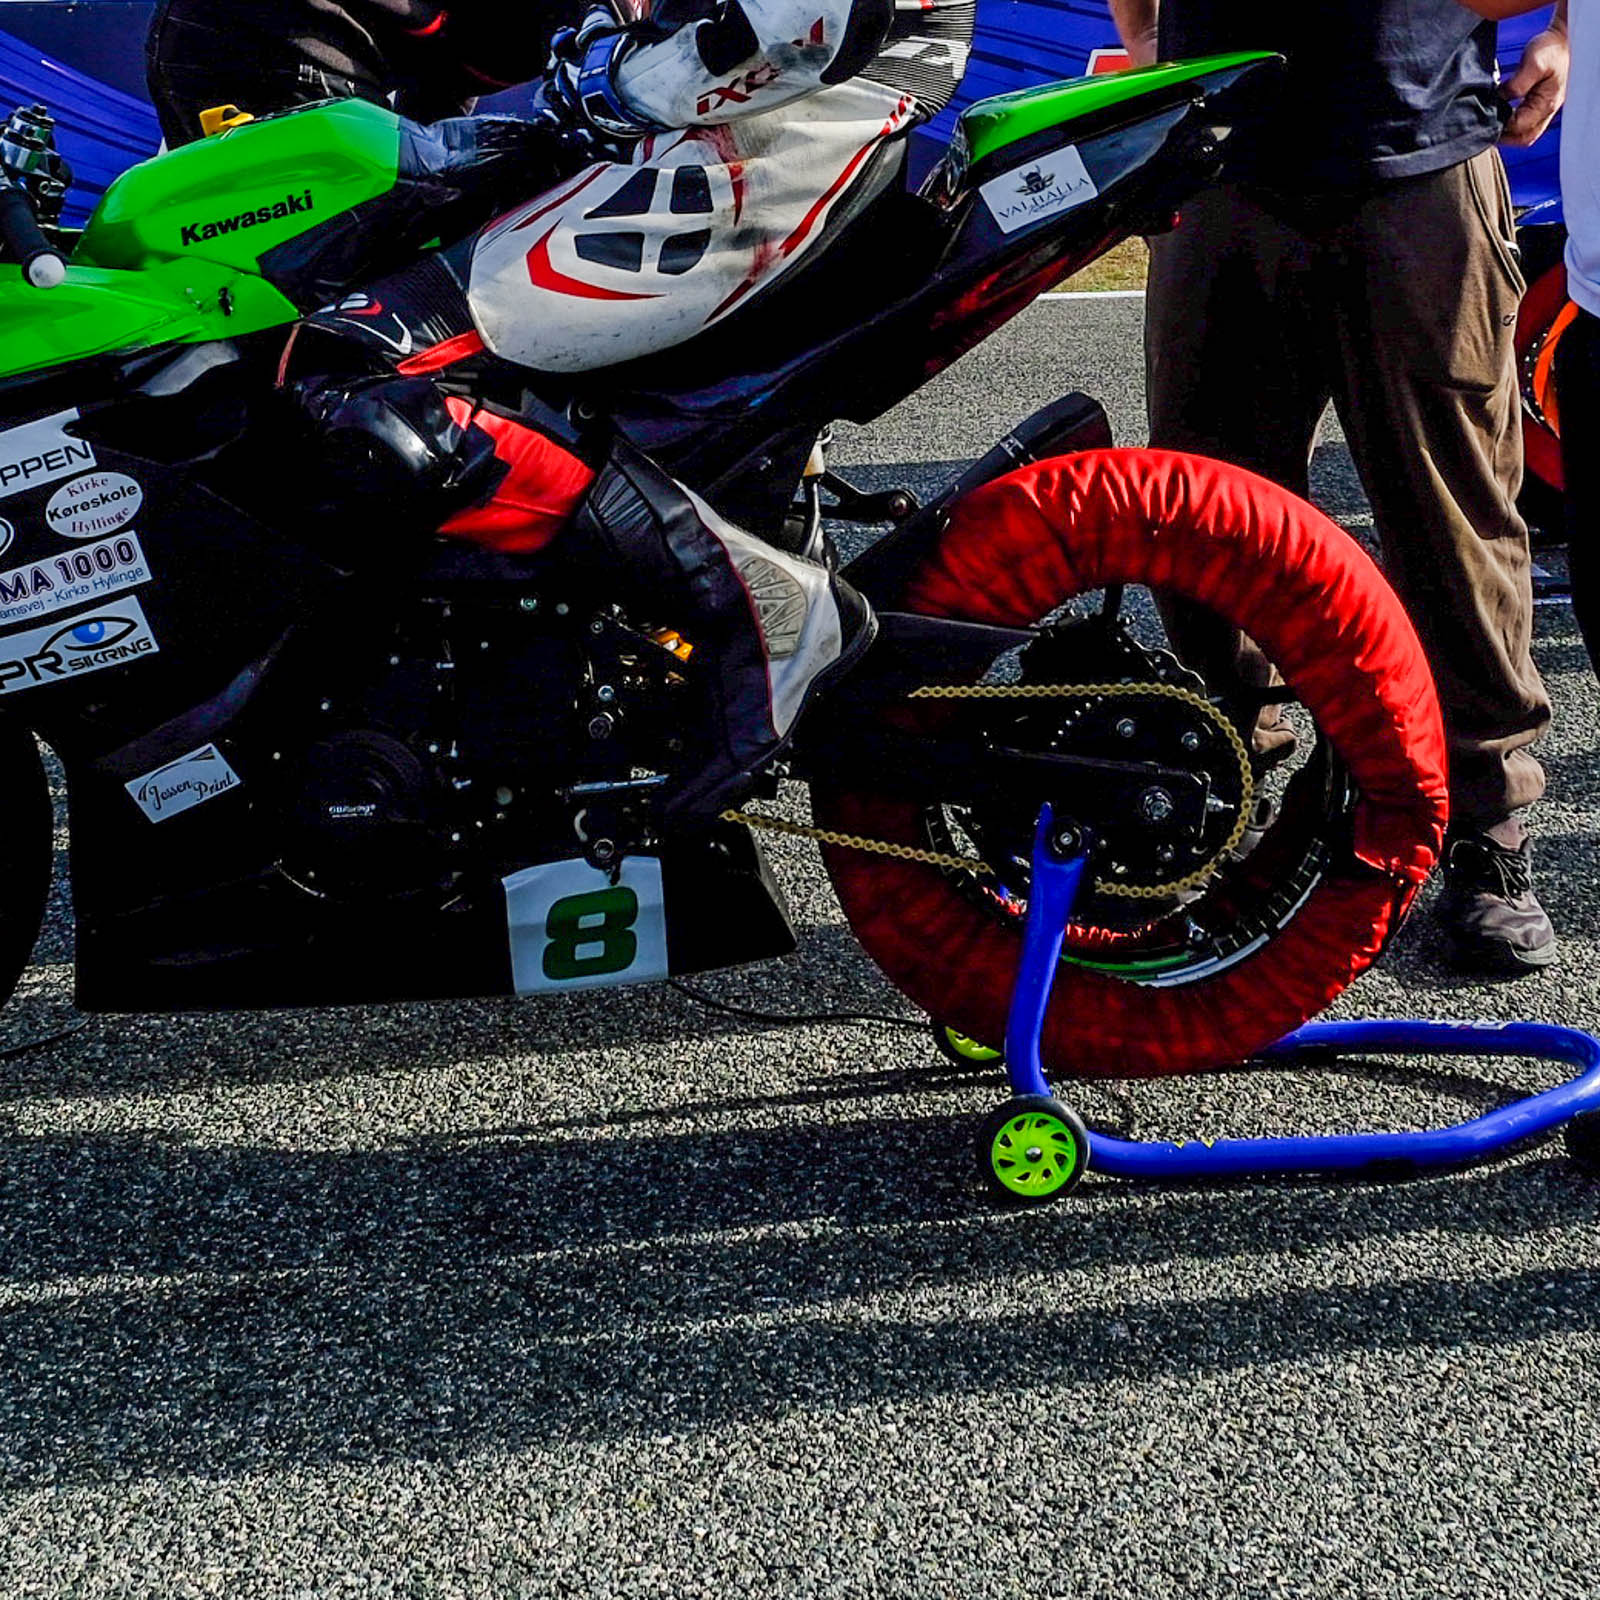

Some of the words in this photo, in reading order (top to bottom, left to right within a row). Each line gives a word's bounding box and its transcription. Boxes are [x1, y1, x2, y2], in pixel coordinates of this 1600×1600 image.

[180, 188, 314, 247] Kawasaki
[997, 177, 1090, 220] VALHALLA
[48, 482, 138, 523] Køreskole
[67, 476, 110, 498] Kirke
[71, 506, 131, 535] Hyllinge
[57, 536, 138, 582] 1000
[93, 565, 145, 593] Hyllinge
[67, 637, 153, 672] SIKRING
[542, 886, 639, 981] 8
